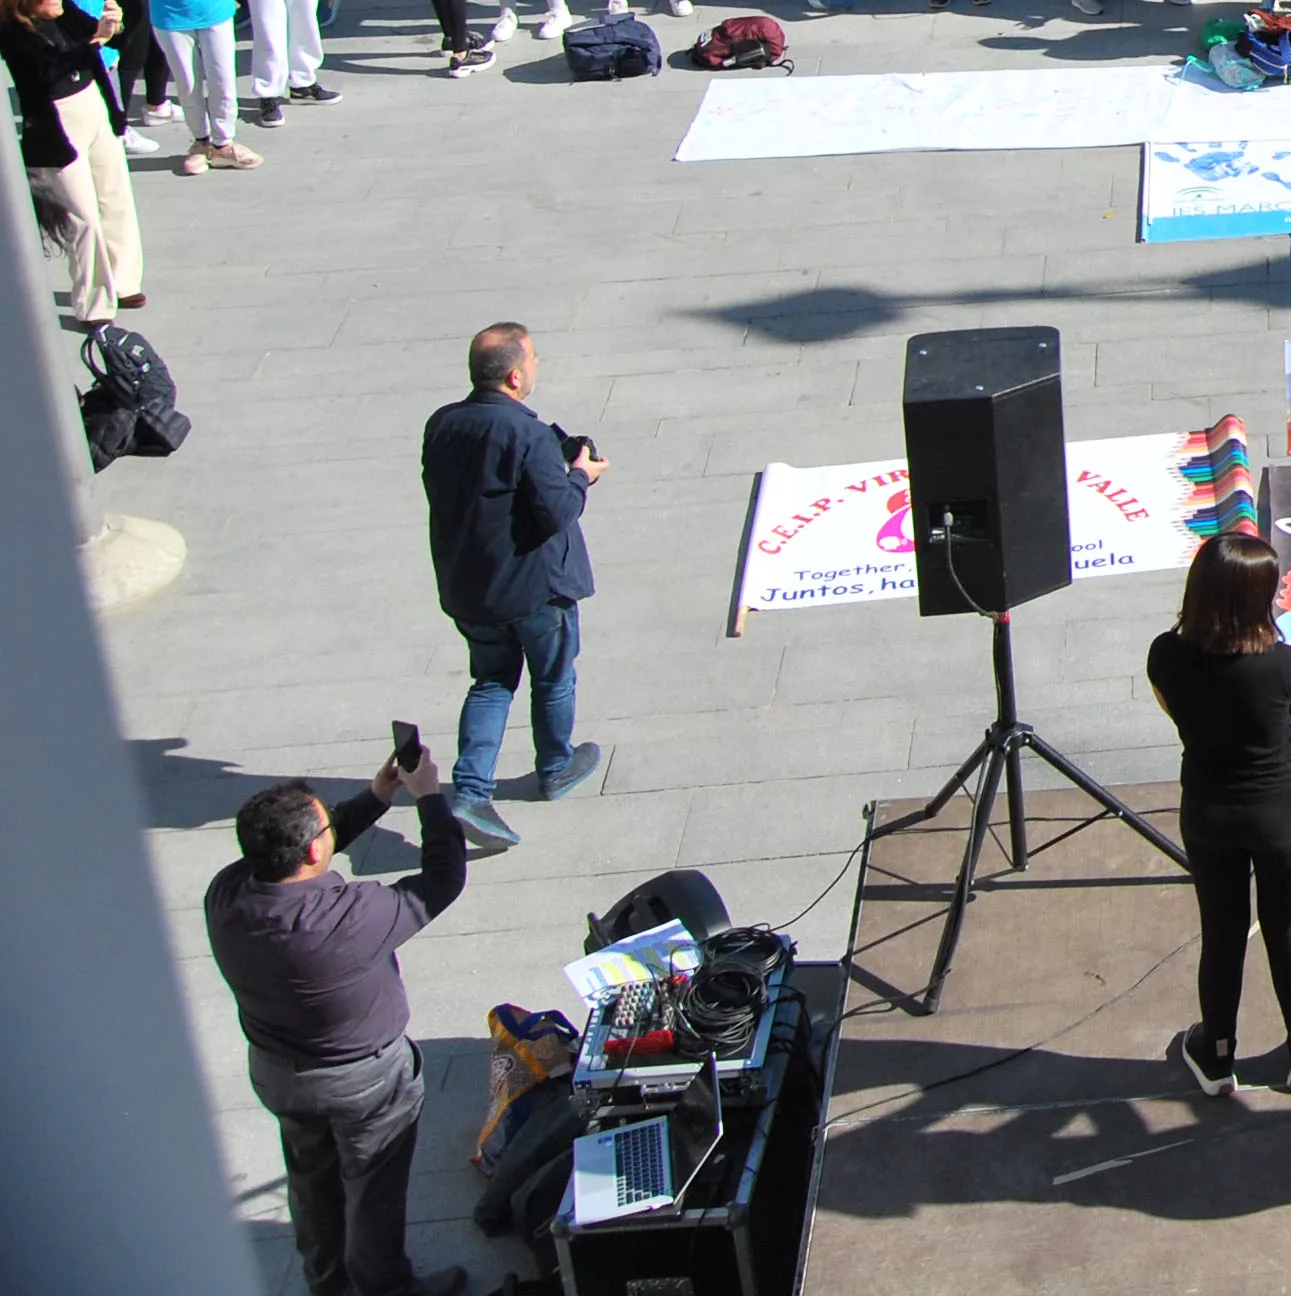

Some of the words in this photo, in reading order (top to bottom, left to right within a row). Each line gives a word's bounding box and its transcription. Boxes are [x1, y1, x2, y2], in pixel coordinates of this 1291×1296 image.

[757, 494, 846, 557] C.E.I.P.
[846, 468, 911, 495] VIR
[1075, 468, 1152, 524] VALLE
[1071, 539, 1104, 553] ool
[760, 578, 877, 604] Juntos,
[881, 575, 916, 593] ha
[1074, 551, 1135, 571] uela
